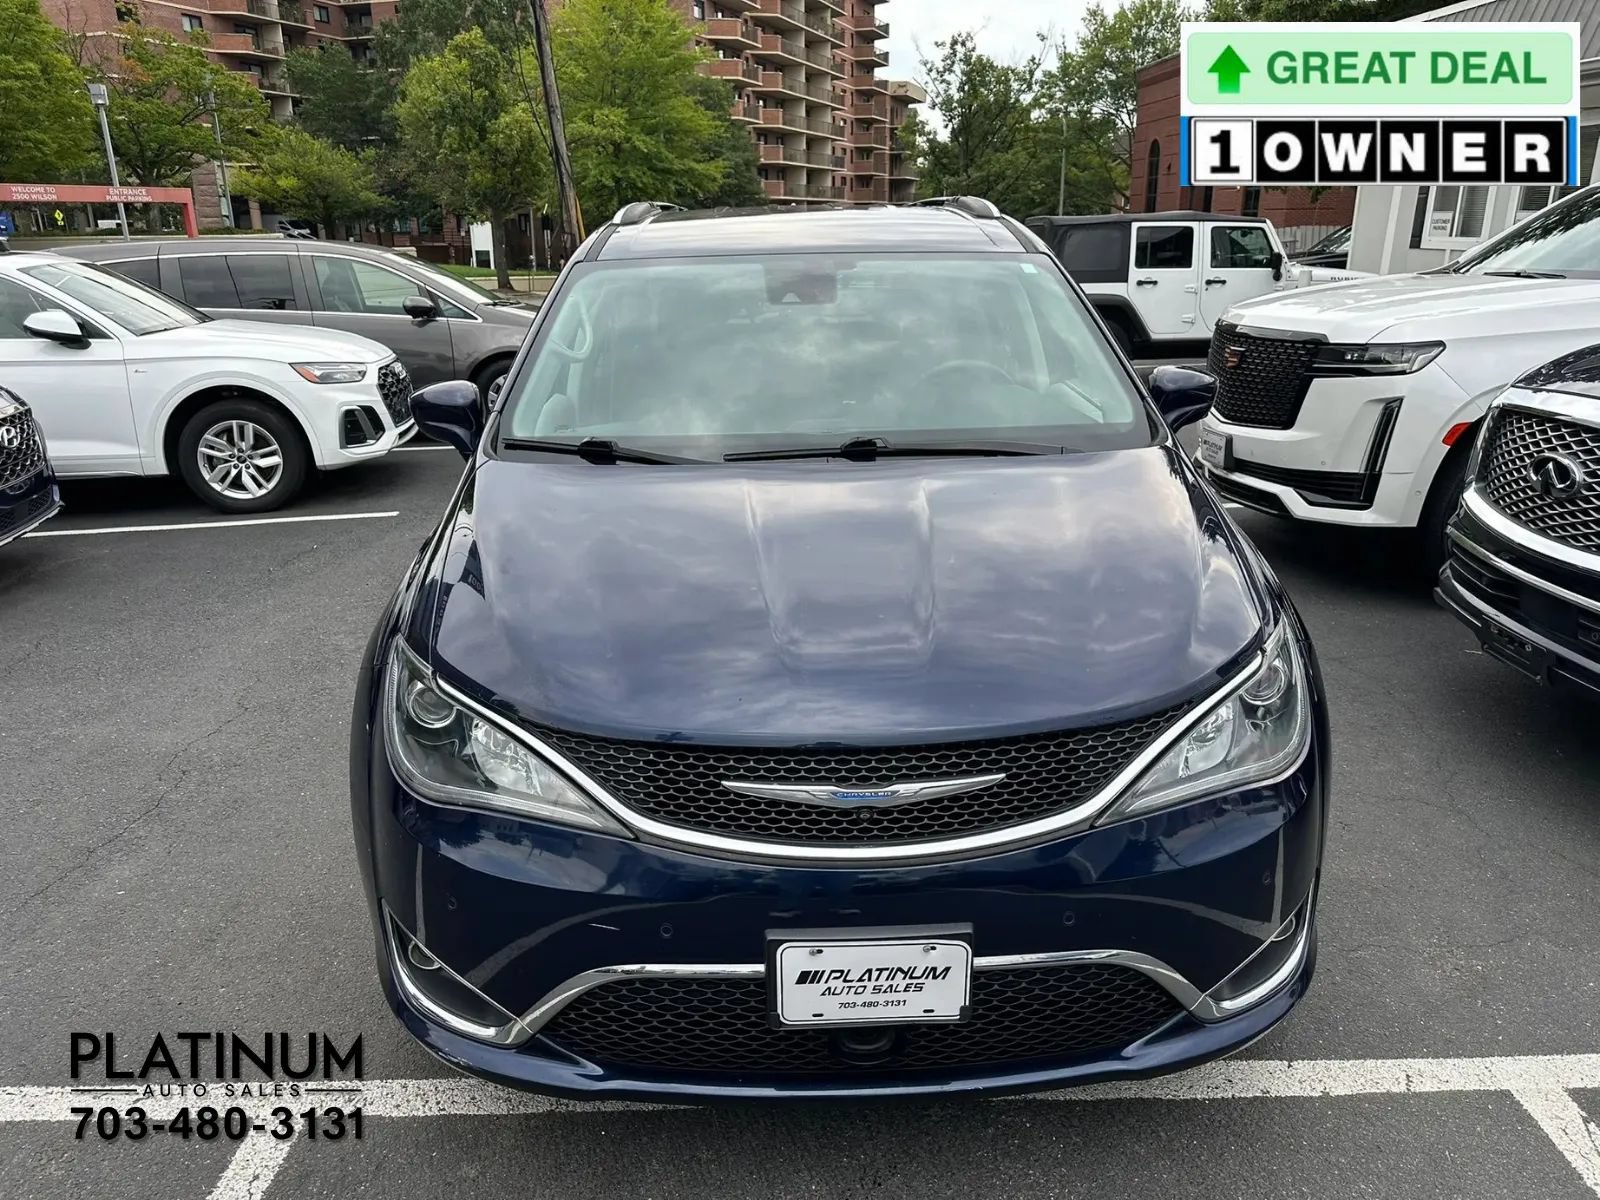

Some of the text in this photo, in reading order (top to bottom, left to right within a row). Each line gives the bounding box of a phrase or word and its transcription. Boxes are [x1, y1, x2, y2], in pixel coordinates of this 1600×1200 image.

[824, 966, 952, 984] PLATINUM
[820, 982, 926, 996] AUTO SALES
[838, 999, 907, 1009] 703-480-3131
